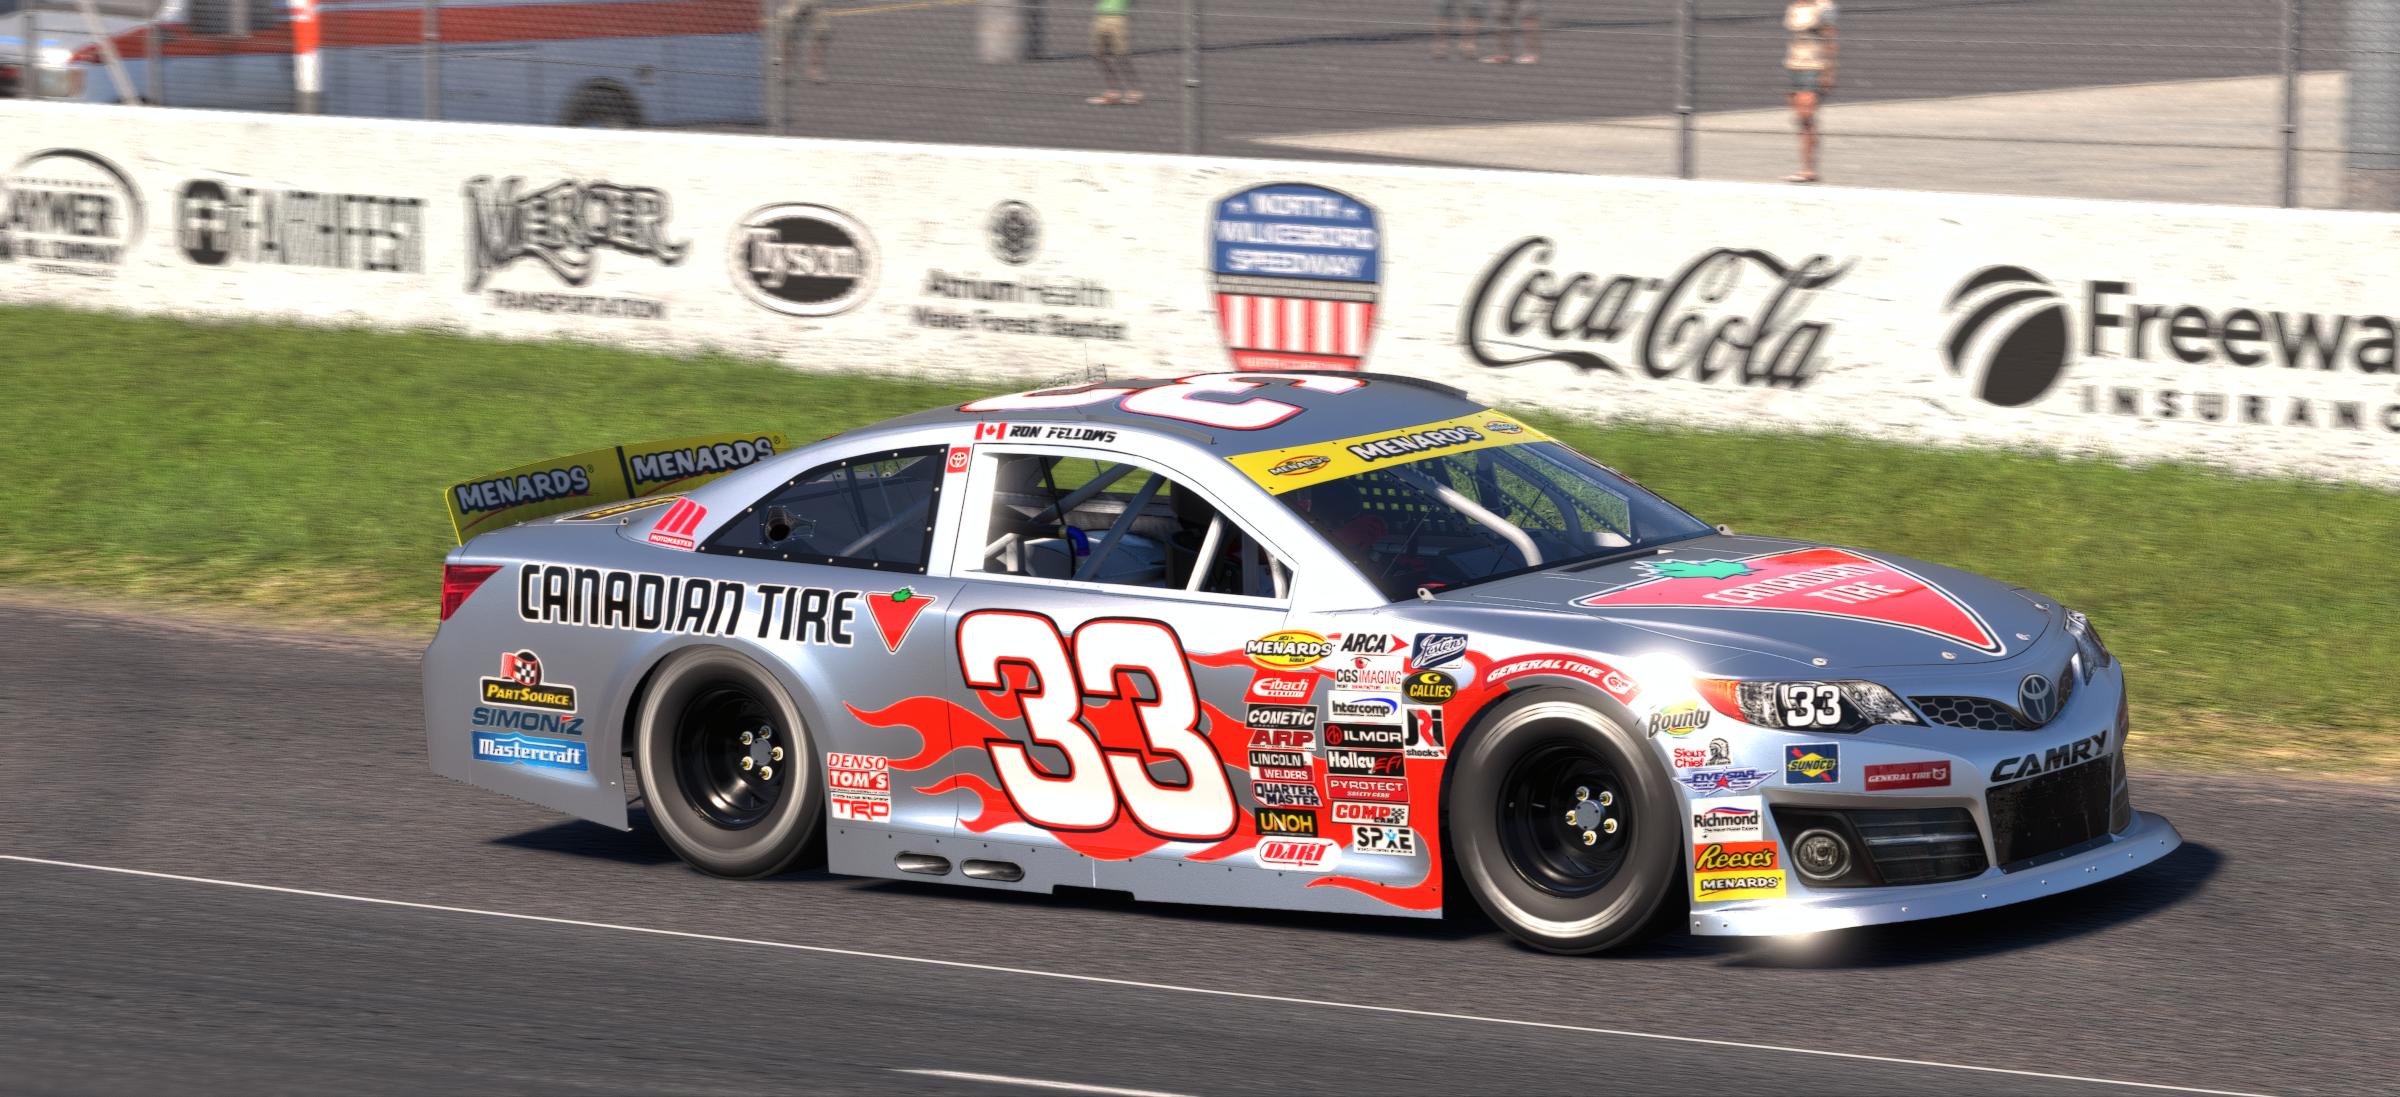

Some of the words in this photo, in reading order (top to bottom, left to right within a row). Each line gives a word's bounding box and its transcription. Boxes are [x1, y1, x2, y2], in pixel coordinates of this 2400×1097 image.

[744, 228, 866, 287] Tyson
[1462, 235, 1858, 389] Coca-Cola
[2085, 279, 2400, 375] Freewa
[1009, 424, 1041, 439] RON
[1046, 426, 1117, 443] FELLOWS
[1348, 426, 1484, 463] MENARDS
[631, 437, 775, 484] MENARDS
[1269, 456, 1330, 476] MENARDS
[456, 466, 591, 512] MENARDS
[651, 534, 693, 548] MOTOMASTER
[1702, 563, 1887, 604] CANADIAN
[1803, 581, 1905, 604] TIRE
[521, 564, 746, 636] CANADIAN
[757, 585, 859, 646] TIRE
[1246, 640, 1332, 657] MENARDS
[1340, 633, 1387, 653] ARCA
[1487, 659, 1562, 682] GENERAL
[1563, 660, 1604, 678] TIRE
[1253, 678, 1309, 696] Eibach
[1410, 684, 1452, 698] CALLIES
[1332, 700, 1390, 717] Intercomp
[1787, 686, 1842, 727] 33
[956, 608, 1239, 843] 33
[1648, 709, 1710, 738] Bounty
[1251, 730, 1313, 746] ARP
[1343, 731, 1402, 742] ILMOR
[479, 738, 581, 764] Mastercraft
[1251, 753, 1301, 766] LINCOLN
[1406, 749, 1439, 757] shocks
[1674, 748, 1706, 758] Sioux
[1990, 730, 2107, 783] CAMRY
[829, 753, 887, 770] DENSO
[1328, 751, 1375, 773] Holley
[1674, 758, 1704, 768] Chief
[1789, 760, 1836, 770] SUNOCO
[830, 771, 887, 789] TOM'S
[1264, 768, 1308, 780] WELDERS
[1692, 772, 1722, 783] FIVE
[1725, 769, 1756, 779] STAR
[1867, 772, 1911, 783] GENERAL
[1912, 772, 1932, 781] TIRE
[1254, 783, 1315, 798] QUARTER
[1330, 780, 1403, 792] PYROTECT
[1266, 792, 1320, 805] MASTER
[832, 798, 889, 820] TRD
[1336, 804, 1391, 819] COMP
[1260, 812, 1313, 832] UNOH
[1694, 810, 1758, 828] Richmond
[1695, 844, 1776, 869] Reese's
[1701, 877, 1777, 890] MENARDS
